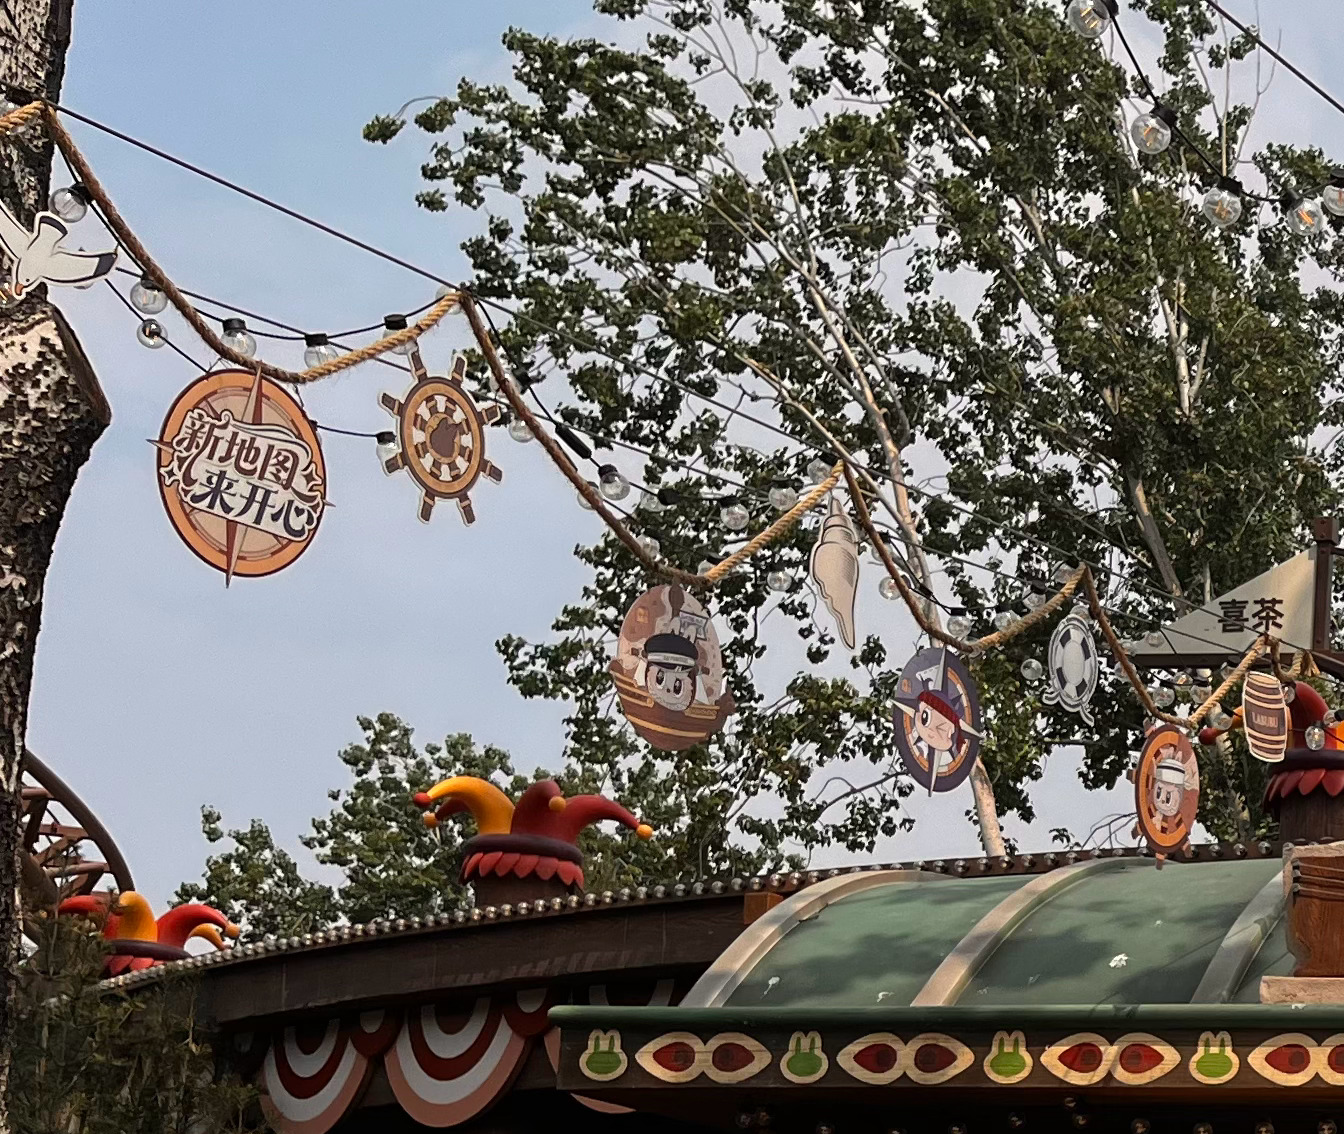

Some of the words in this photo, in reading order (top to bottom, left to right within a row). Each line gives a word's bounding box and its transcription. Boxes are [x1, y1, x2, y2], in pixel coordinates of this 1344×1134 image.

[175, 409, 301, 490] 新地图
[190, 469, 315, 538] 来开心
[1217, 597, 1285, 634] 喜茶
